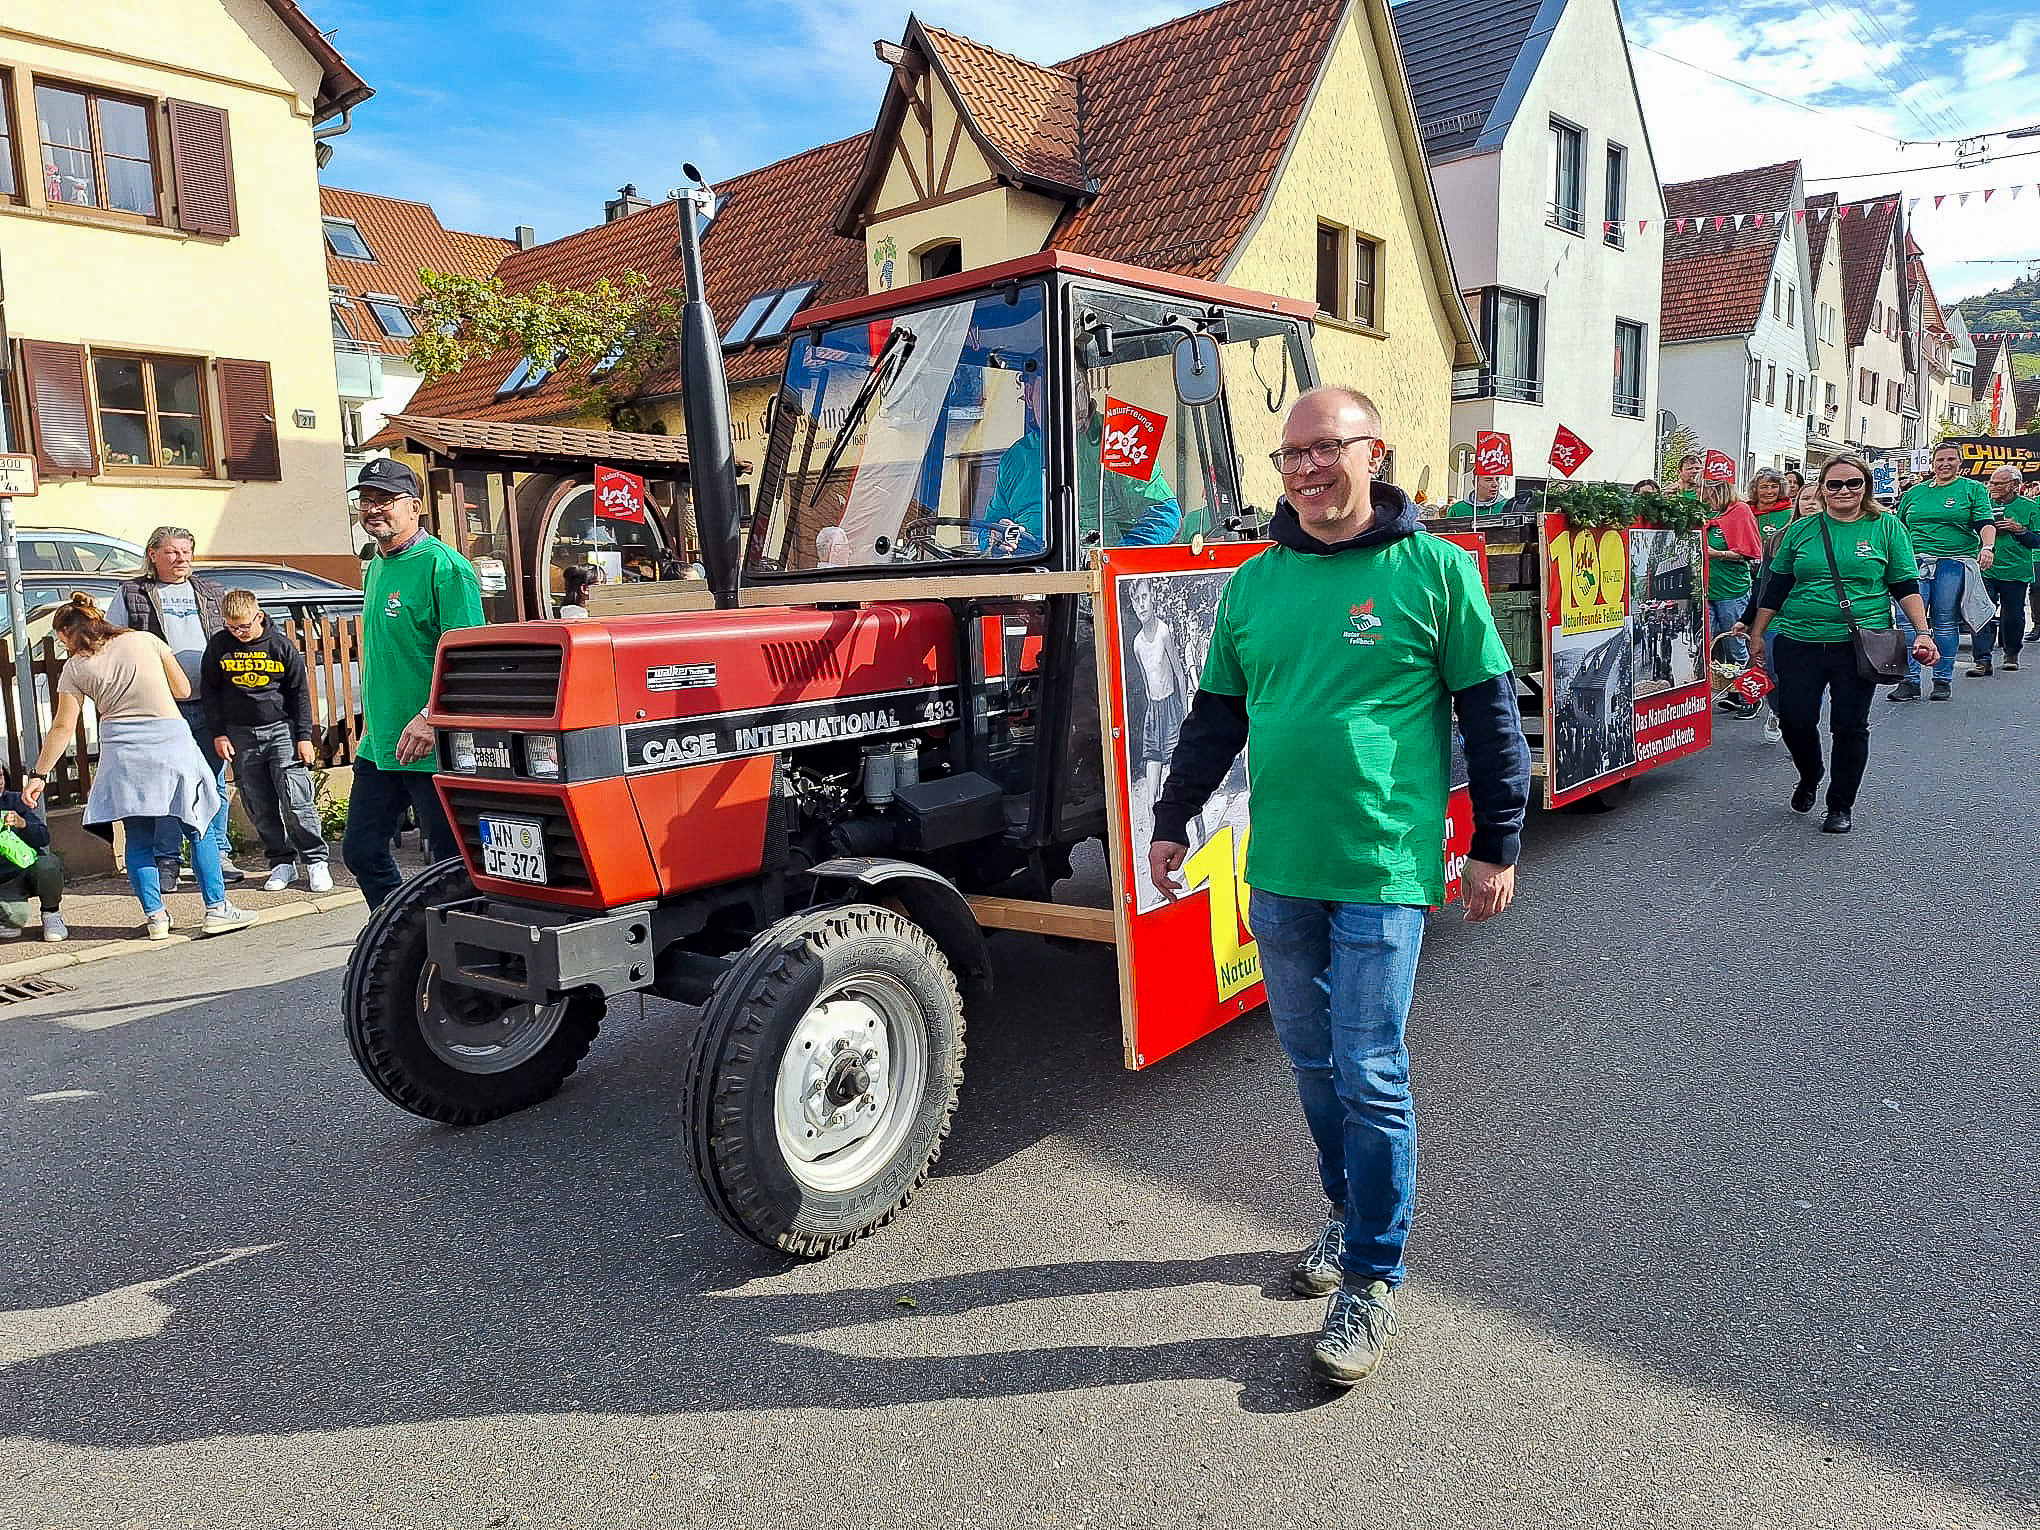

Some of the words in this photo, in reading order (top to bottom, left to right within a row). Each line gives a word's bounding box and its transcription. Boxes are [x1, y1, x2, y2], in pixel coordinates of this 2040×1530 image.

[1961, 443, 2027, 460] CHULE
[1550, 529, 1626, 607] 100
[642, 732, 718, 765] CASE
[734, 708, 900, 751] INTERNATIONAL
[923, 700, 955, 722] 433
[1635, 712, 1648, 732] Das
[1636, 739, 1664, 761] Gestern
[1663, 728, 1676, 751] und
[1676, 726, 1695, 747] Heute
[491, 823, 514, 848] WN
[488, 849, 507, 873] JF
[510, 852, 541, 879] 372
